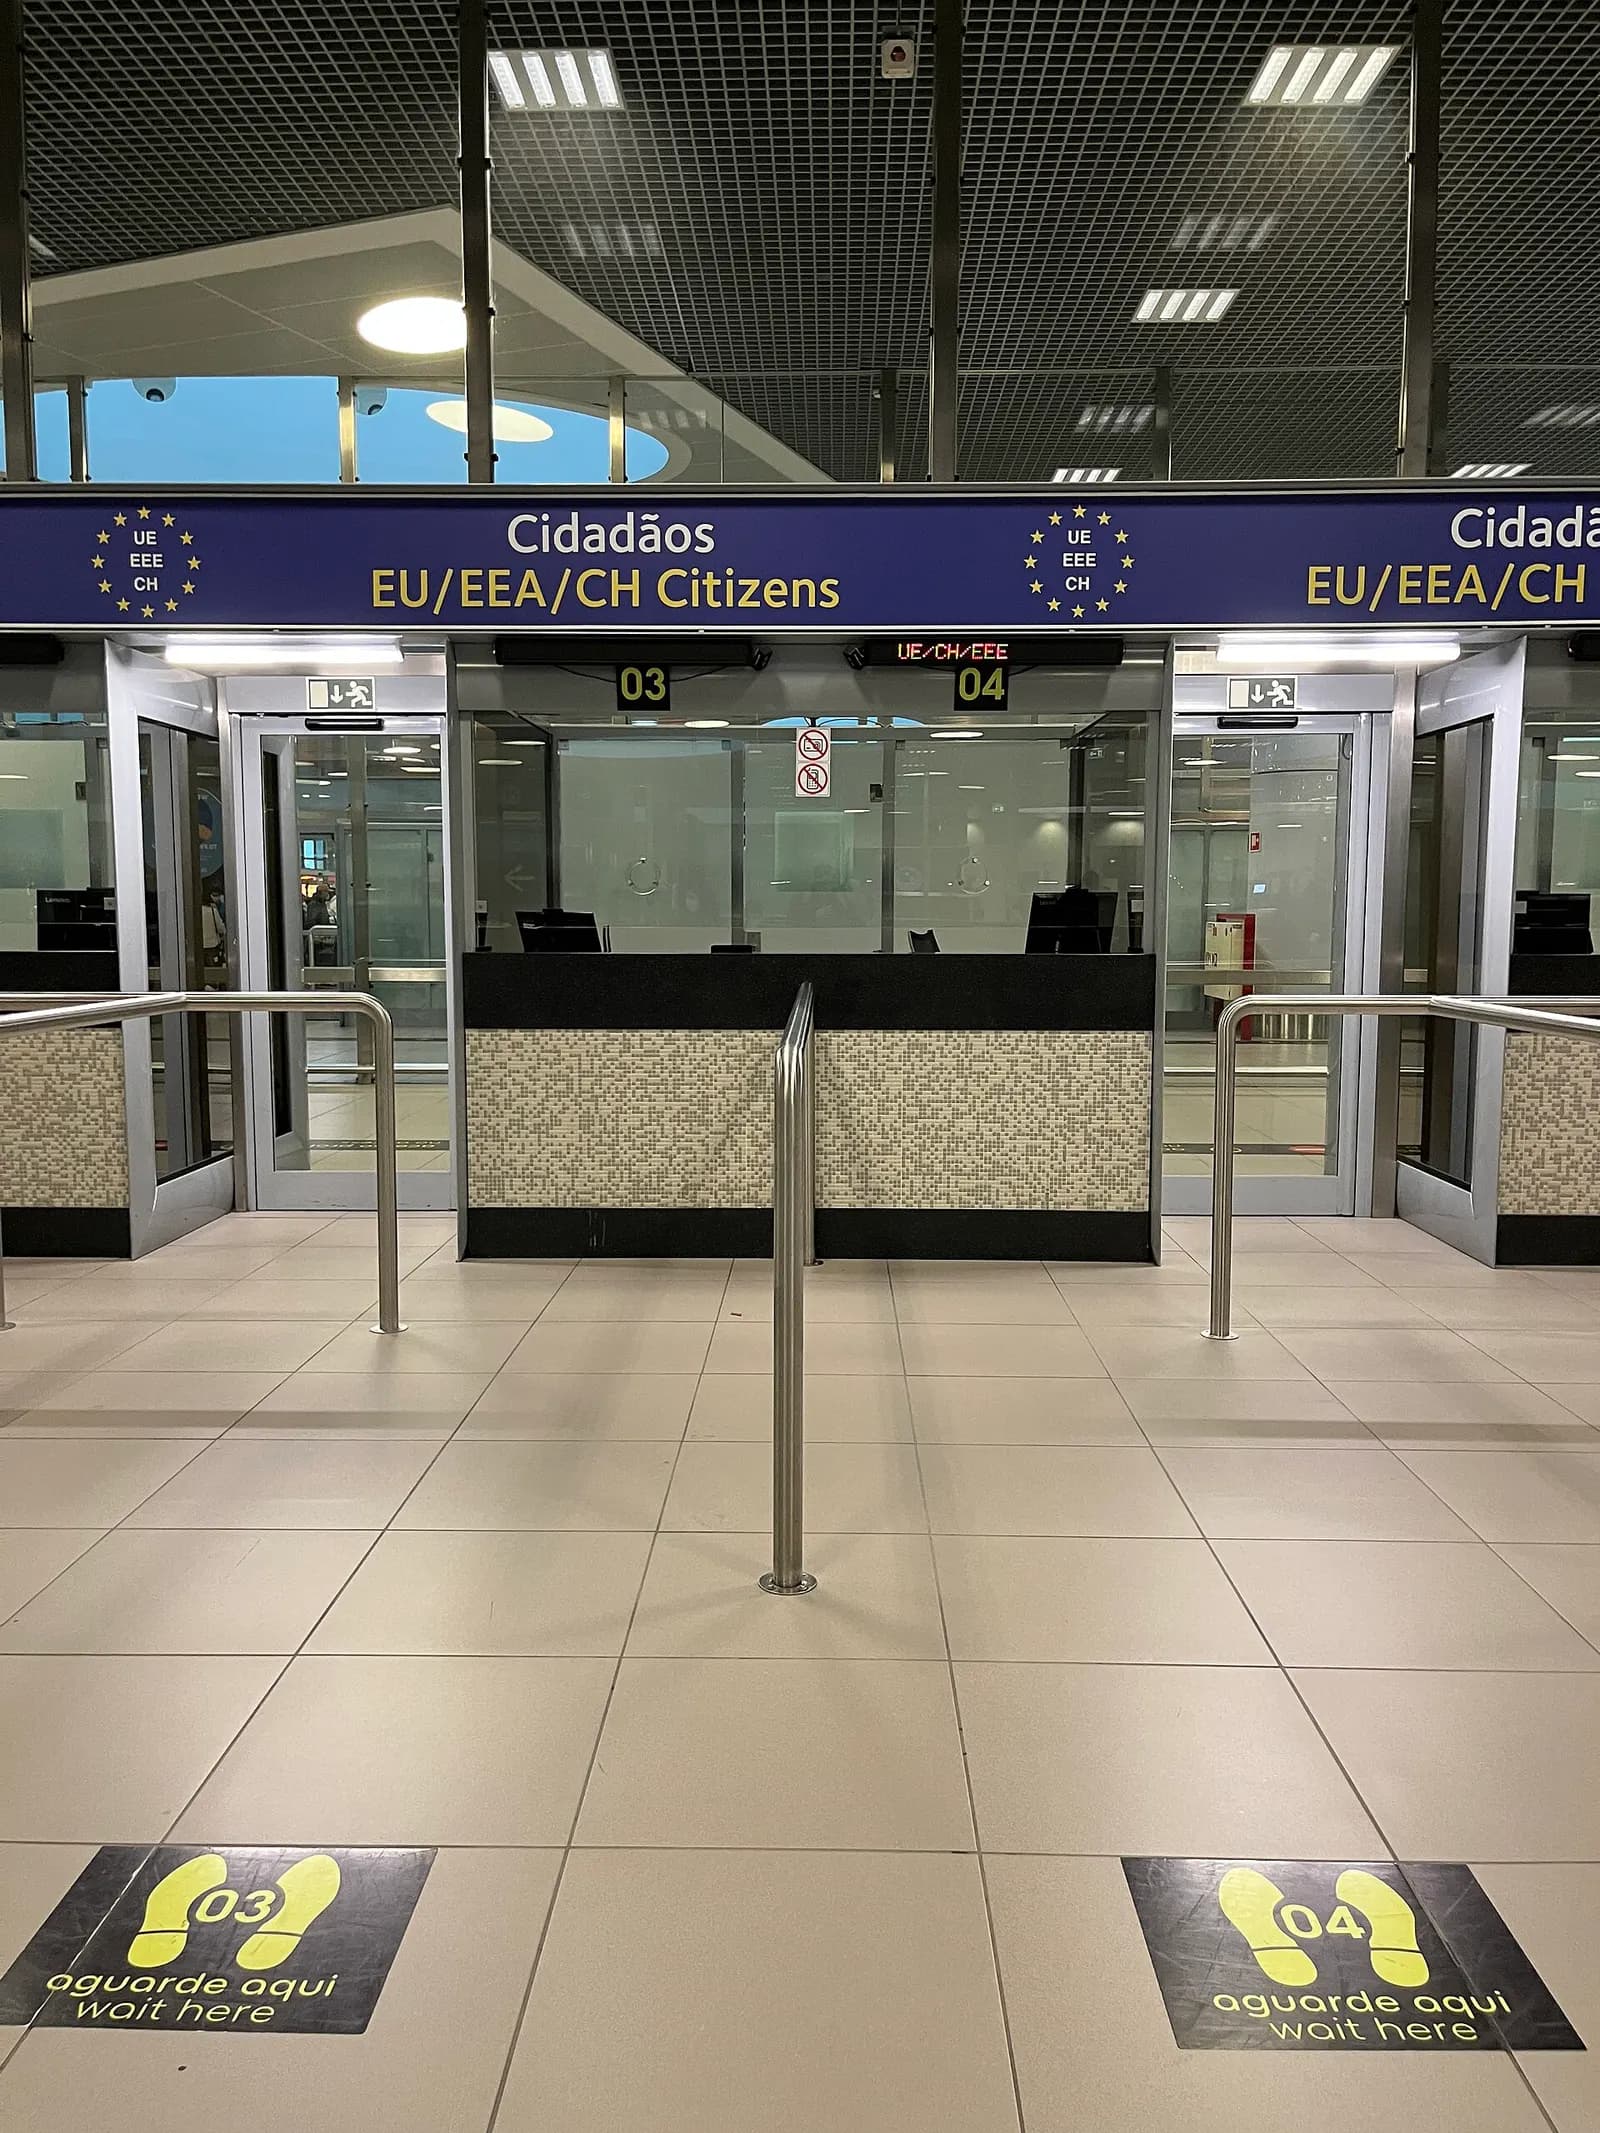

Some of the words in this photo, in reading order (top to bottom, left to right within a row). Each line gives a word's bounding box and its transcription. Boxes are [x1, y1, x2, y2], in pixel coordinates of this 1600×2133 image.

[133, 530, 157, 546] UE
[507, 511, 715, 554] Cidadãos
[1068, 529, 1092, 545] UE
[1451, 505, 1600, 548] Cidadã
[129, 553, 164, 568] EEE
[1063, 552, 1097, 567] EEE
[134, 576, 158, 592] CH
[371, 568, 640, 615] EU/EEA/CH
[656, 567, 840, 609] Citizens
[1065, 576, 1090, 591] CH
[1307, 562, 1586, 612] EU/EEA/CH
[898, 643, 1009, 660] UE/CH/EEE
[621, 666, 666, 701] 03
[959, 667, 1005, 701] 04
[194, 1888, 277, 1923] 03
[1280, 1903, 1366, 1940] 04
[46, 1972, 229, 1996] aguarde
[240, 1973, 338, 2002] aqui
[76, 1996, 167, 2021] wait
[176, 1998, 275, 2024] here
[1213, 1990, 1402, 2018] aguarde
[1413, 1990, 1512, 2018] aqui
[1270, 2016, 1367, 2041] wait
[1374, 2016, 1479, 2041] here
